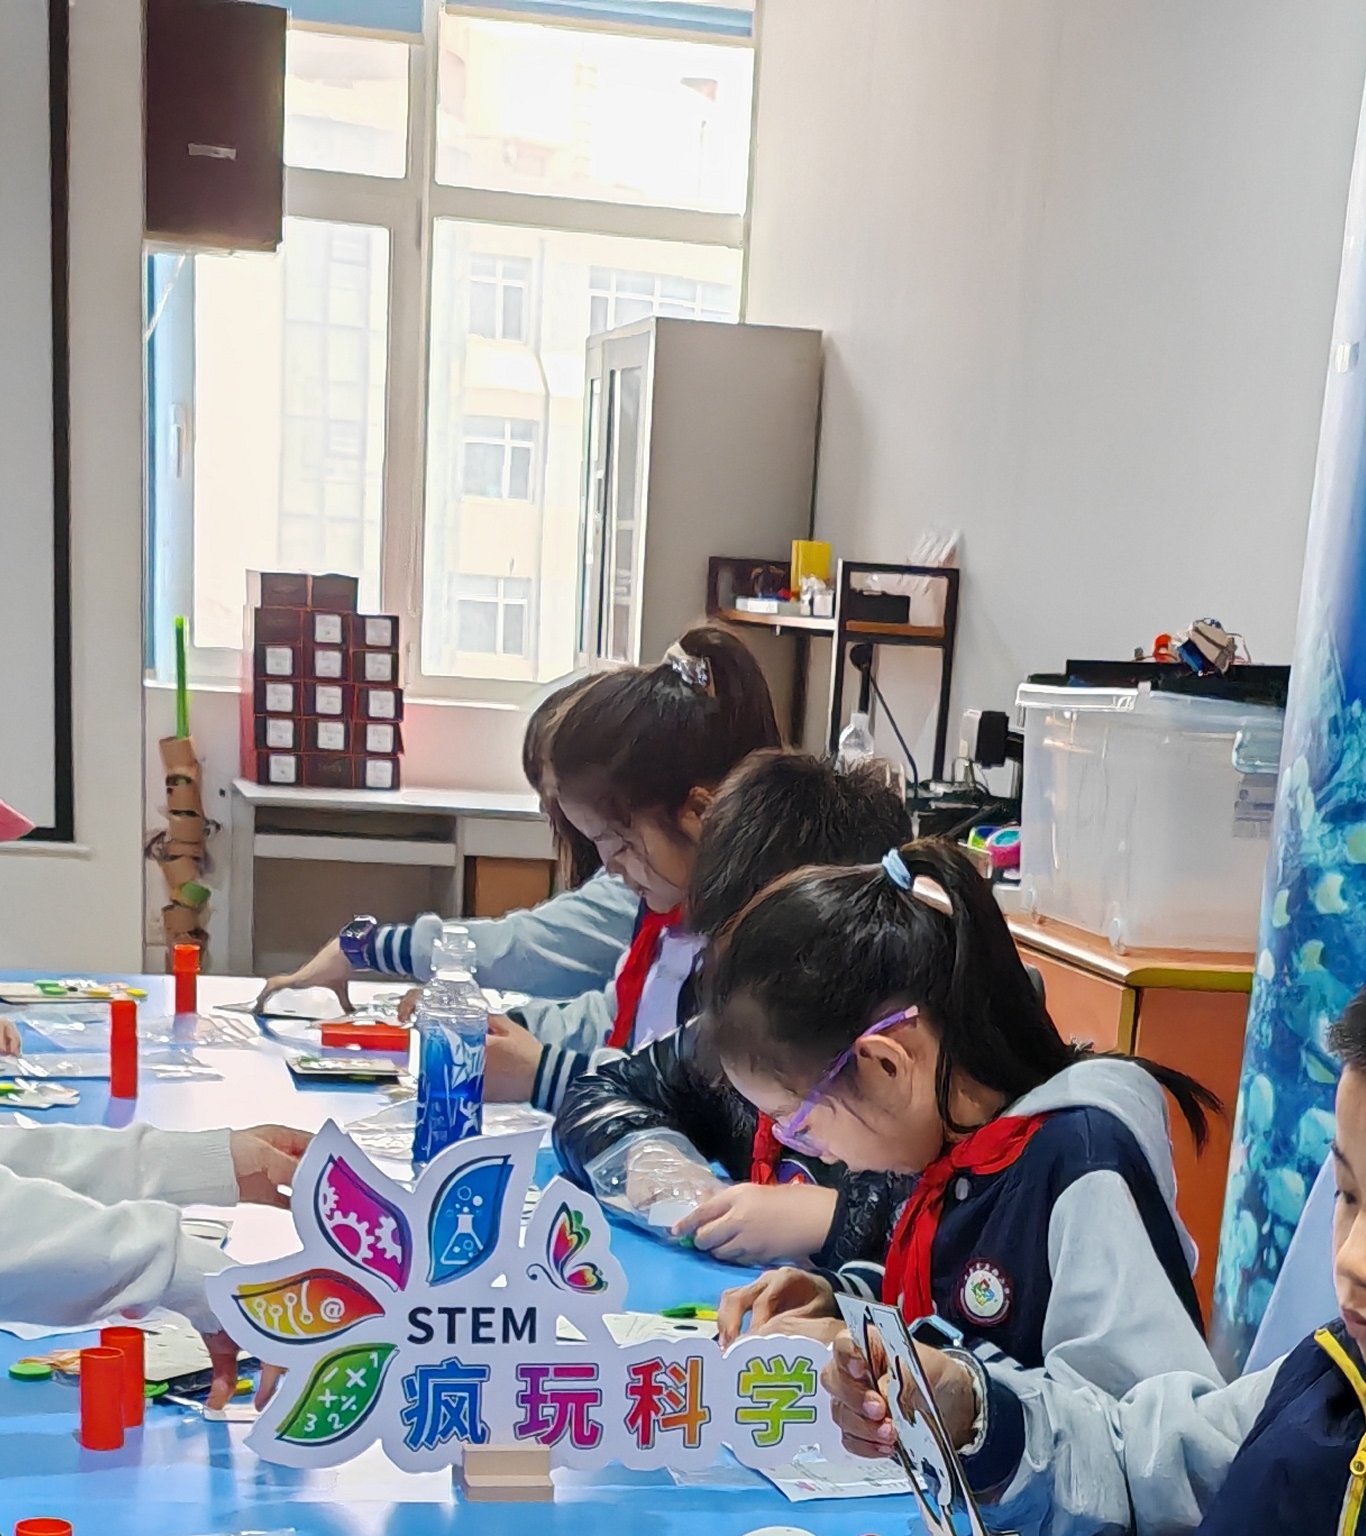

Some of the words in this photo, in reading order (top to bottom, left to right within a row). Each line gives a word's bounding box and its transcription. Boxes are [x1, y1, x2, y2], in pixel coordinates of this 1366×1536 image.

[407, 1306, 538, 1345] STEM
[399, 1354, 818, 1451] 疯玩科学
